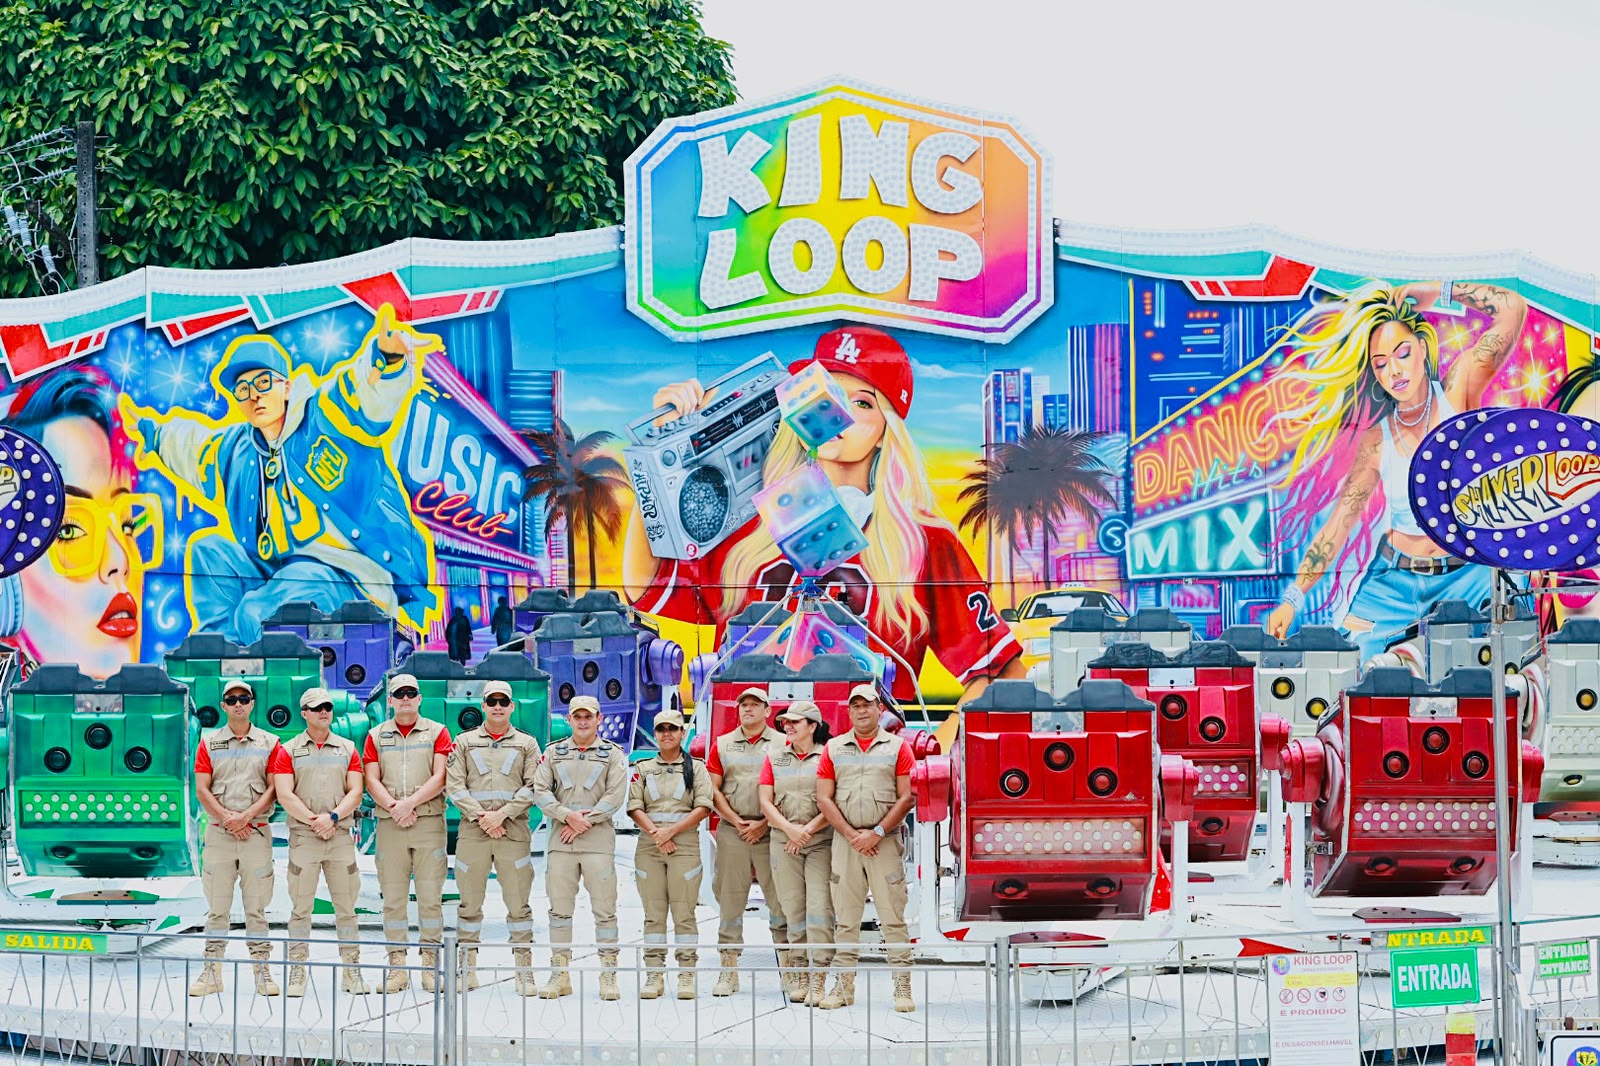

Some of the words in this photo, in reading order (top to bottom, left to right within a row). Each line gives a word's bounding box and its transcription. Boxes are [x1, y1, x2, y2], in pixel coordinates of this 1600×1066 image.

[697, 113, 983, 217] KING
[699, 215, 983, 309] LOOP
[835, 333, 861, 364] LA
[391, 400, 521, 525] USIC
[1134, 380, 1313, 504] DANCE
[1192, 453, 1263, 500] Hits
[1455, 455, 1561, 528] SHAKER
[1545, 451, 1600, 500] LOOP
[412, 479, 513, 538] Club
[1135, 502, 1265, 570] MIX
[967, 591, 999, 632] 2
[5, 934, 94, 951] SALIDA
[1294, 955, 1320, 966] KING
[1323, 954, 1353, 965] LOOP
[1387, 929, 1486, 947] NTRADA
[1540, 943, 1588, 959] ENTRADA
[1398, 963, 1472, 993] ENTRADA
[1540, 960, 1589, 976] ENTRANCE
[1290, 1008, 1347, 1016] PROIBIDO
